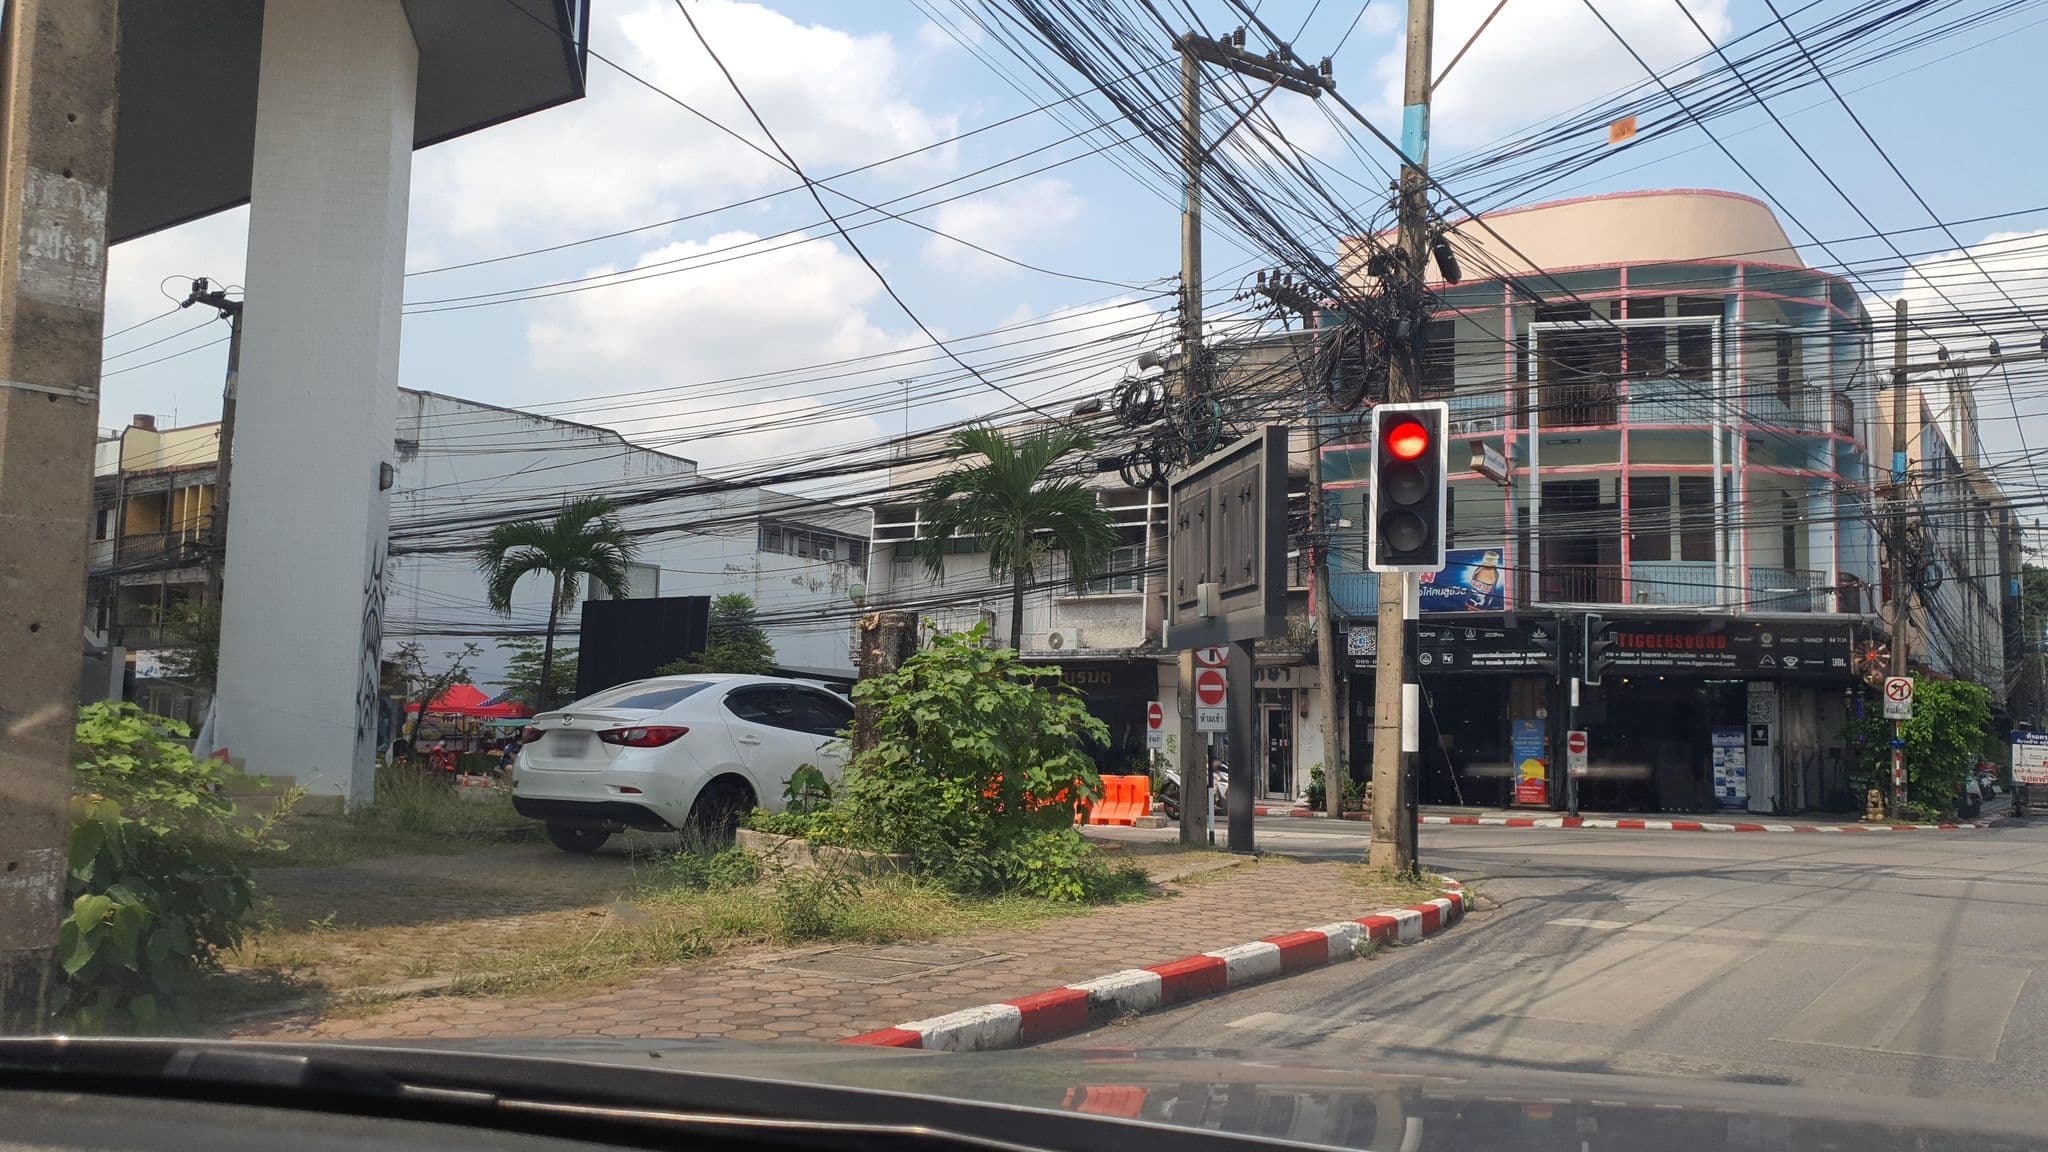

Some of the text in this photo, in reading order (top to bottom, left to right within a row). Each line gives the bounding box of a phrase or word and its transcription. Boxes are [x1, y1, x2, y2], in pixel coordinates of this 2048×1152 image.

[1618, 634, 1727, 649] TIGGERSOUND
[1832, 657, 1847, 667] JBL
[1200, 711, 1224, 723] ห้ามเข้า
